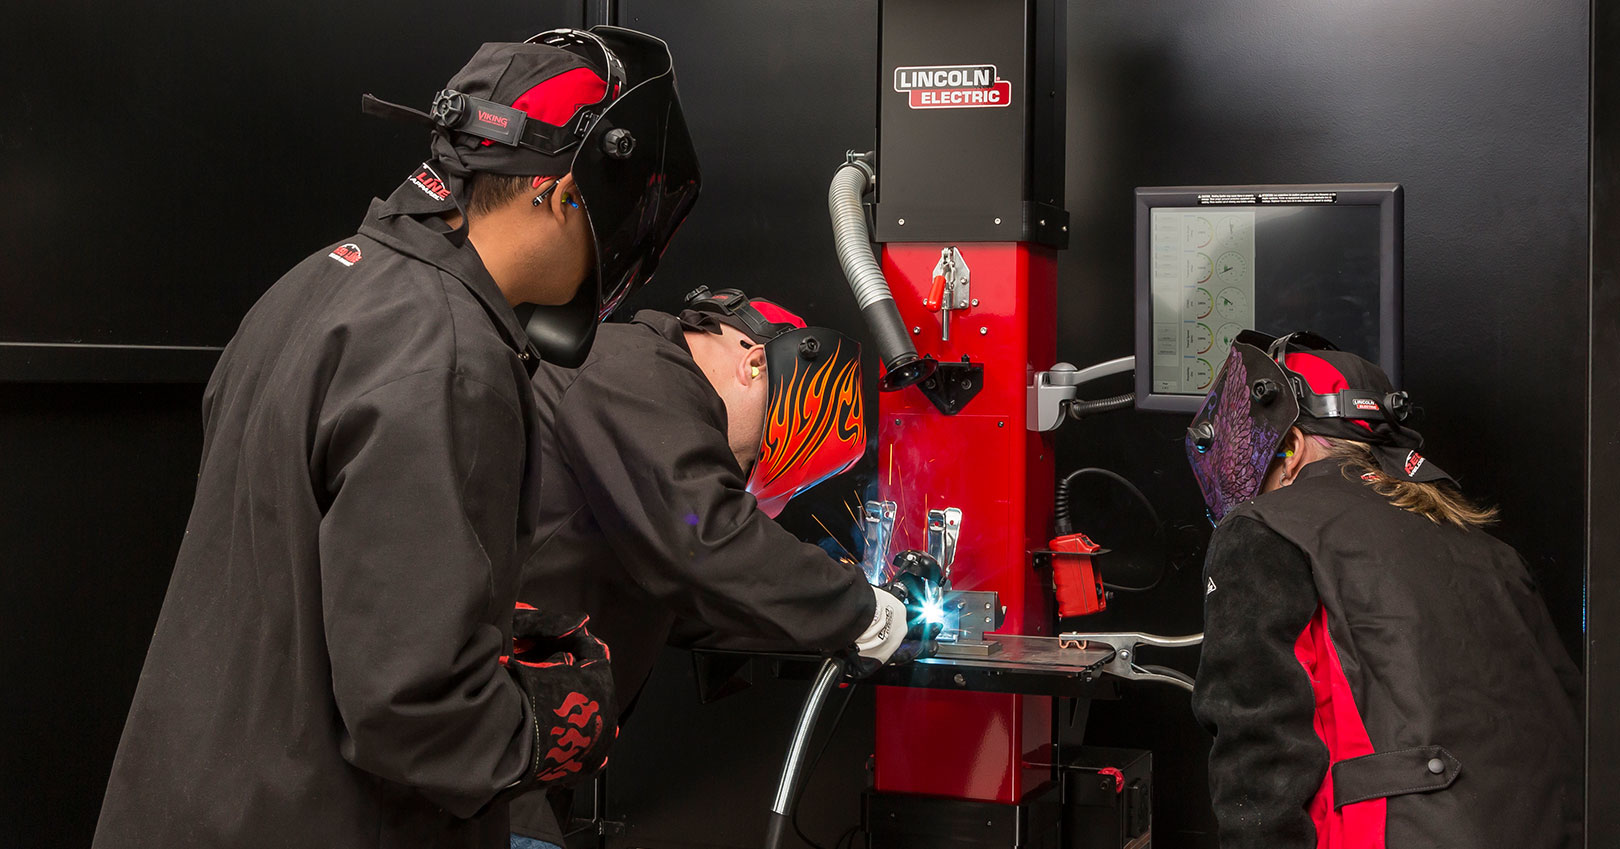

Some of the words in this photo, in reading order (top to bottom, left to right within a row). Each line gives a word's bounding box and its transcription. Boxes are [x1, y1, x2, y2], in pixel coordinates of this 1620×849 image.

[900, 69, 990, 88] LINCOLN
[921, 90, 1000, 104] ELECTRIC
[478, 110, 508, 128] VIKING
[416, 171, 451, 199] LINE
